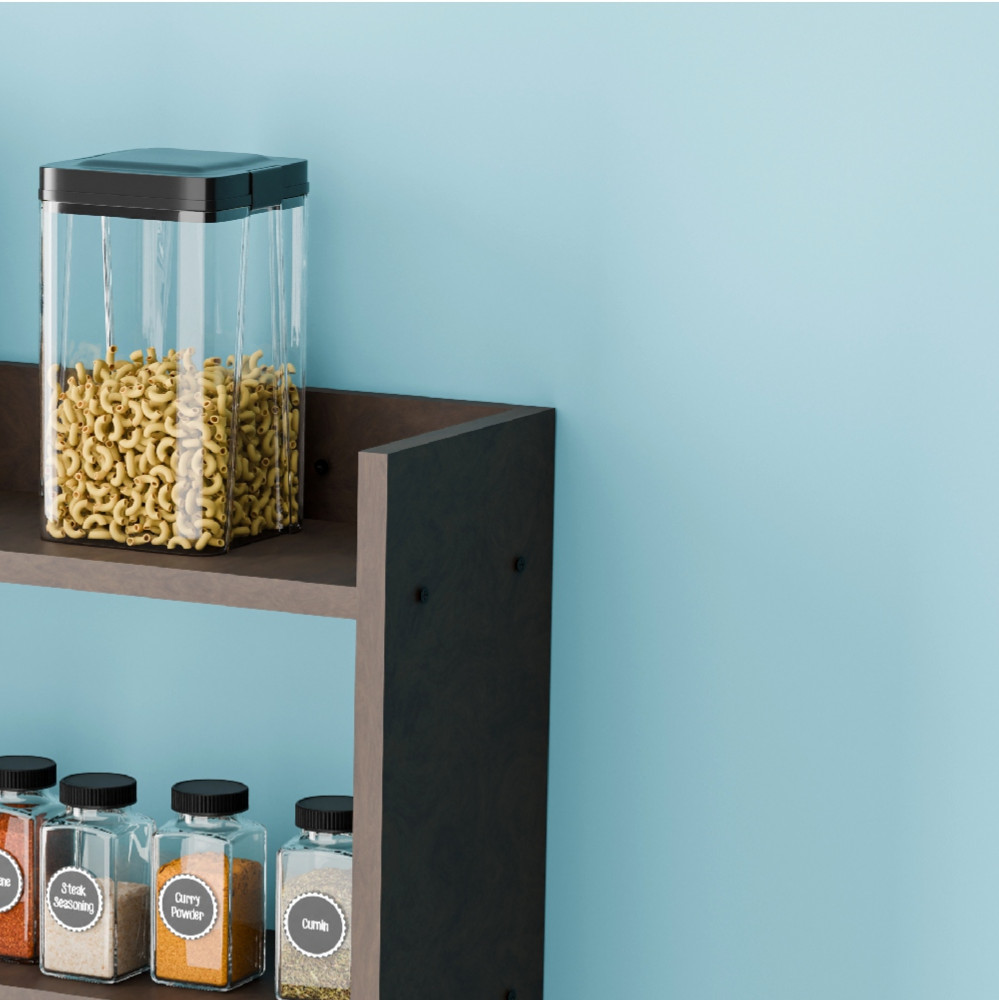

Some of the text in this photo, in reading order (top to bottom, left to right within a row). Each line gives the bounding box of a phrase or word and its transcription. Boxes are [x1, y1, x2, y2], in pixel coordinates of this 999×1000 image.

[61, 882, 87, 897] Steak
[53, 896, 94, 915] Seasoning
[175, 892, 201, 907] Curry
[171, 905, 205, 921] Powder
[302, 918, 329, 932] Cumin
